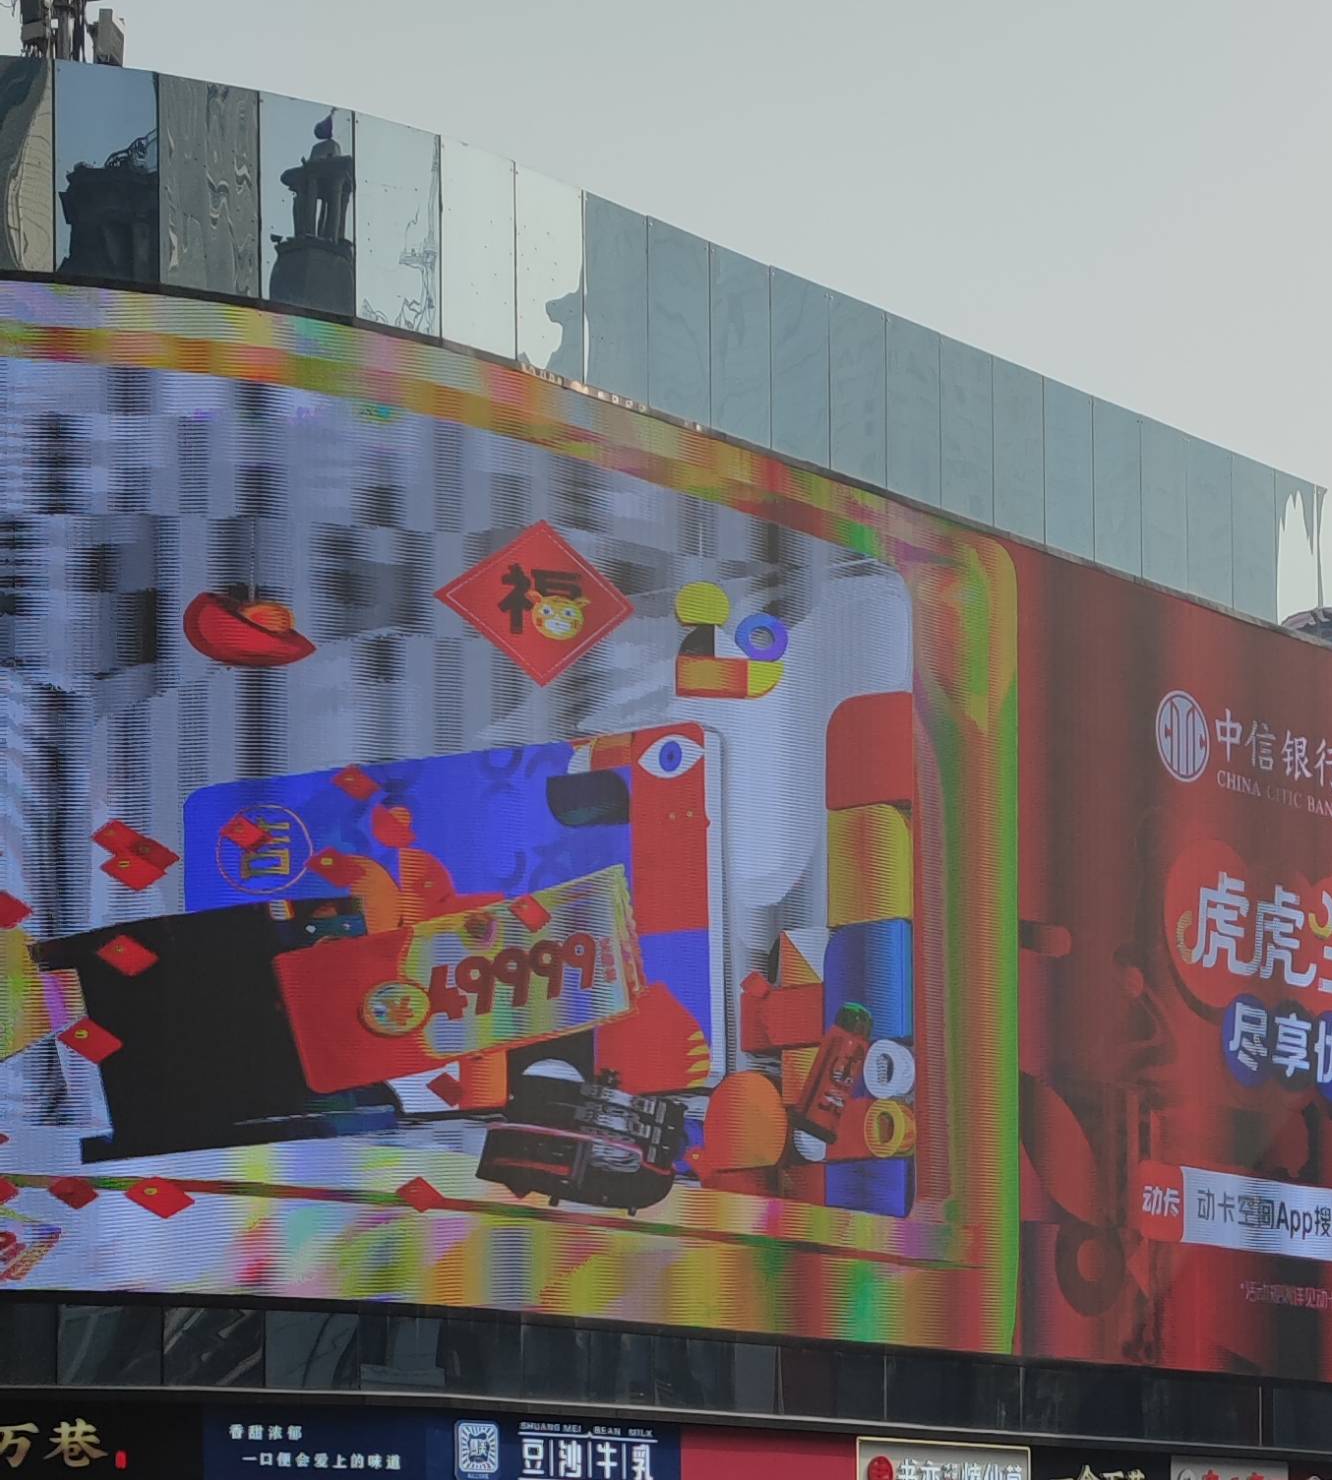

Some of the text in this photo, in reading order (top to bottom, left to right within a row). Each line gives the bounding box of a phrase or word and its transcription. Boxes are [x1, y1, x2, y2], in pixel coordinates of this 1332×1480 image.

[1216, 770, 1261, 797] CHINA
[1266, 783, 1302, 809] CITIC
[1142, 1185, 1181, 1217] 动卡
[0, 1418, 109, 1468] 万巷
[229, 1424, 303, 1440] 香甜浓郁
[563, 1424, 582, 1433] MEI
[593, 1426, 621, 1436] BEAN
[242, 1452, 402, 1470] 一口便会爱上的味道
[521, 1438, 654, 1480] 豆沙牛乳
